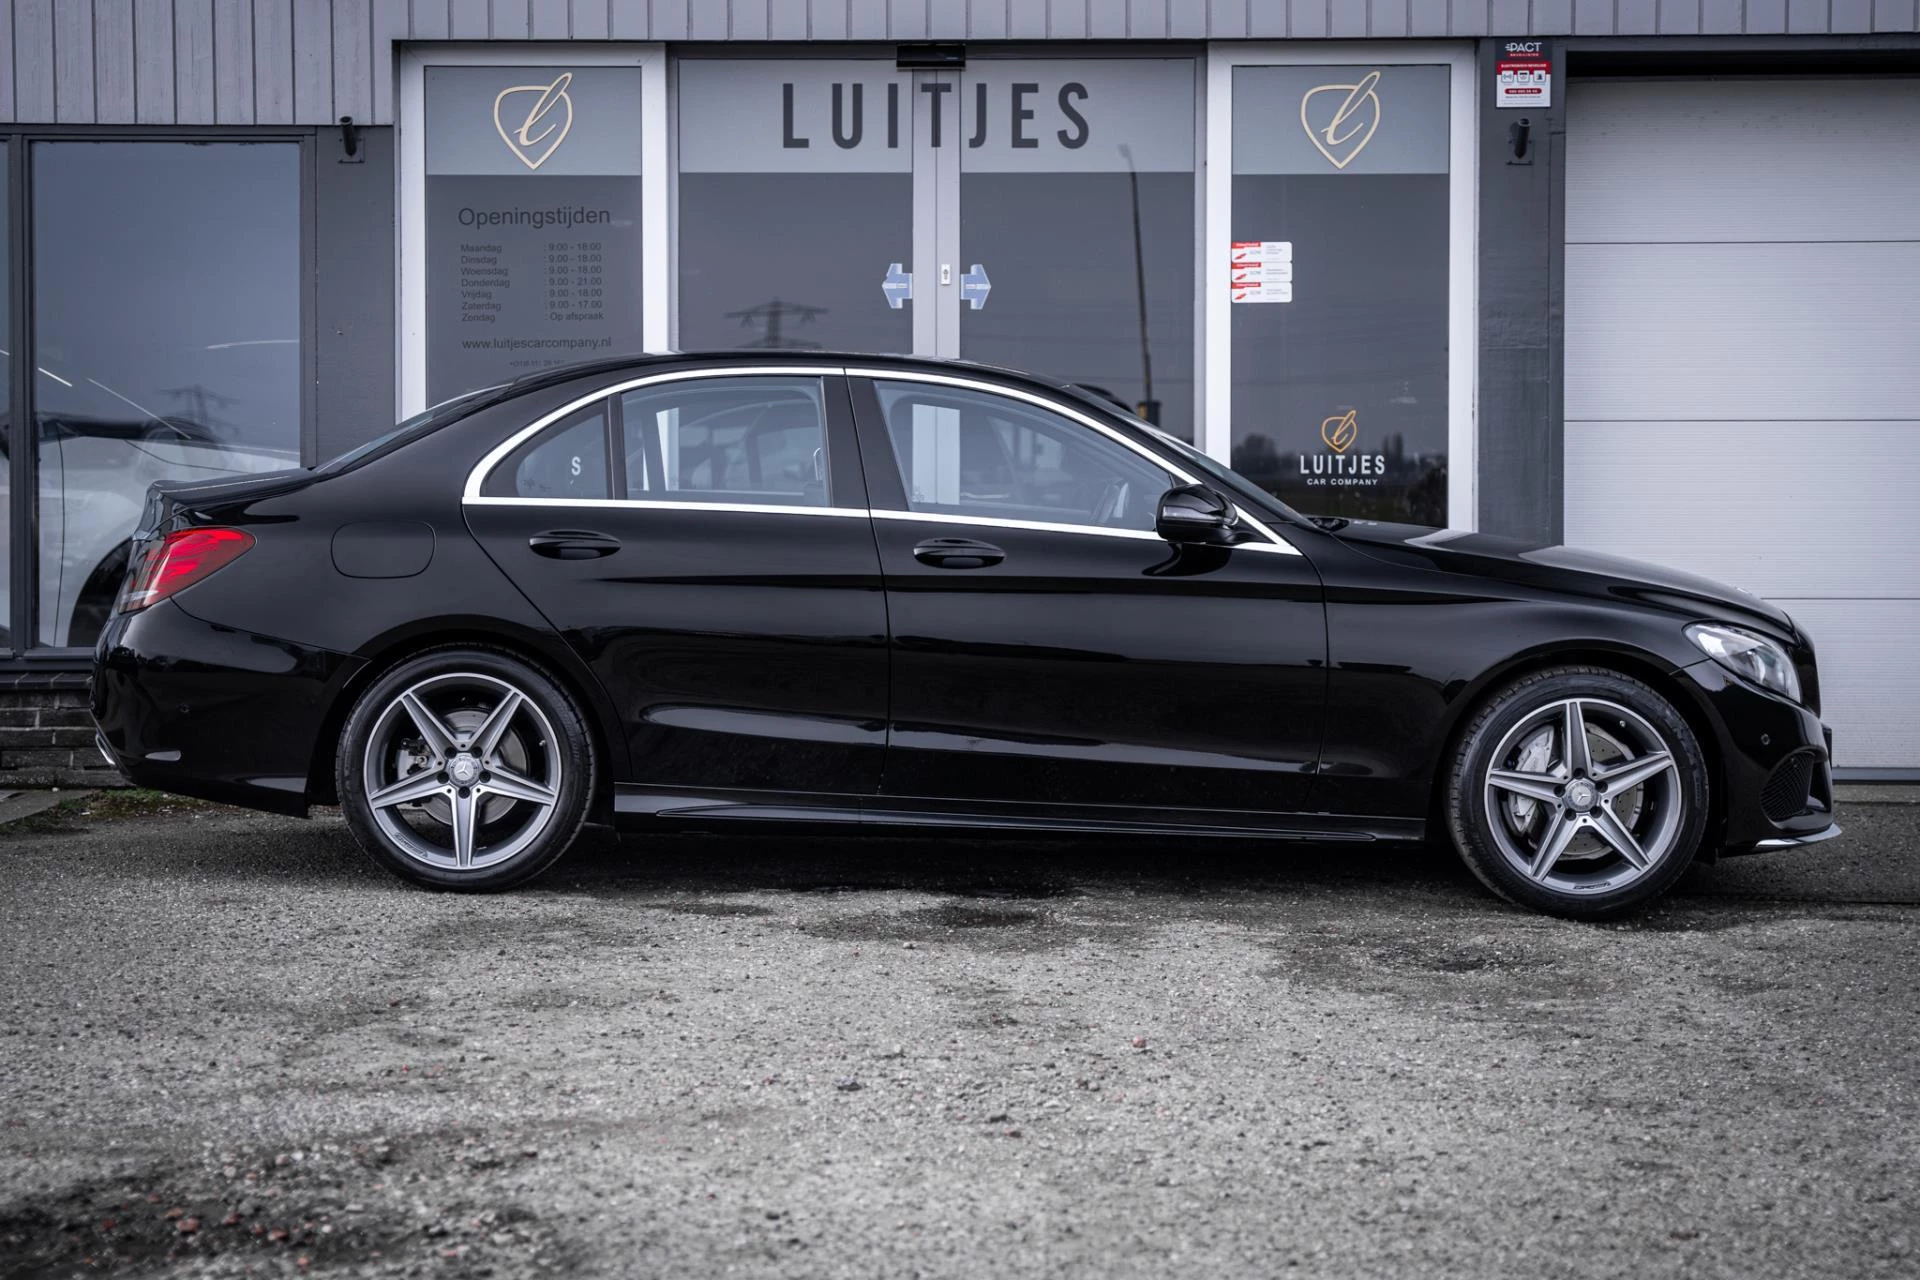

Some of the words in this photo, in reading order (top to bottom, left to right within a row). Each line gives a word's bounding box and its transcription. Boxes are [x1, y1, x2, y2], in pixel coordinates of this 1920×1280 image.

[1506, 42, 1542, 52] PACT
[782, 82, 1090, 149] LUITJES
[458, 206, 611, 229] Openingstijden
[548, 242, 569, 251] 9.00
[461, 255, 498, 265] Dinsdag
[548, 254, 569, 263] 9.00
[548, 266, 569, 275] 9.00
[461, 278, 511, 288] Donderdag
[549, 277, 569, 286] 9.00
[462, 290, 492, 300] Vrijdag
[549, 289, 569, 298] 9.00
[549, 300, 569, 309] 9.00
[462, 313, 496, 324] Zondag
[550, 311, 563, 321] Op
[566, 310, 604, 321] afspraak
[462, 337, 612, 350] www.luitjescarcompany.nl
[1300, 455, 1385, 475] LUITJES
[1306, 478, 1327, 486] CAR
[1330, 478, 1378, 486] COMPANY
